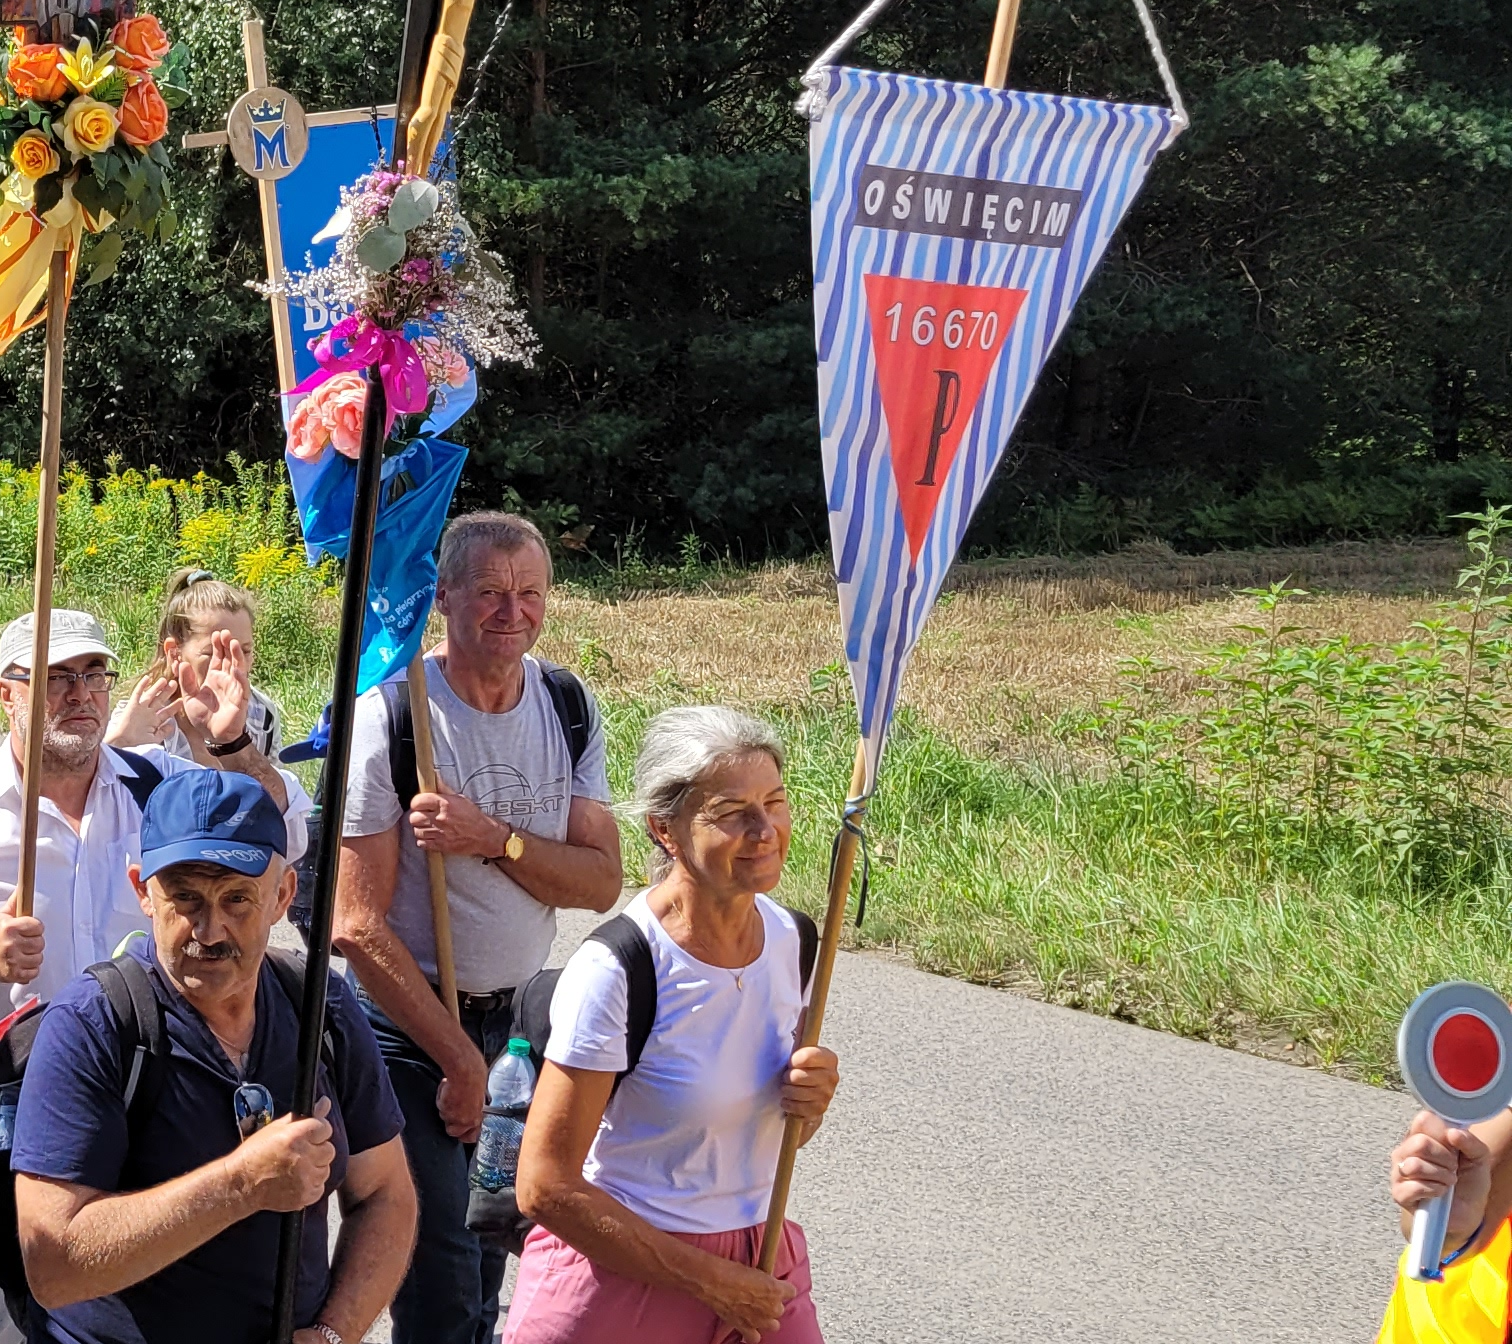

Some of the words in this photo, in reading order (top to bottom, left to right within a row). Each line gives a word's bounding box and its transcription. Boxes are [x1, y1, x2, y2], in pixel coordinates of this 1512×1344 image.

[251, 121, 293, 172] M
[863, 175, 1071, 239] OŚWIĘCIM
[884, 301, 1000, 351] 16670
[914, 369, 962, 487] P
[200, 849, 269, 862] SPORT
